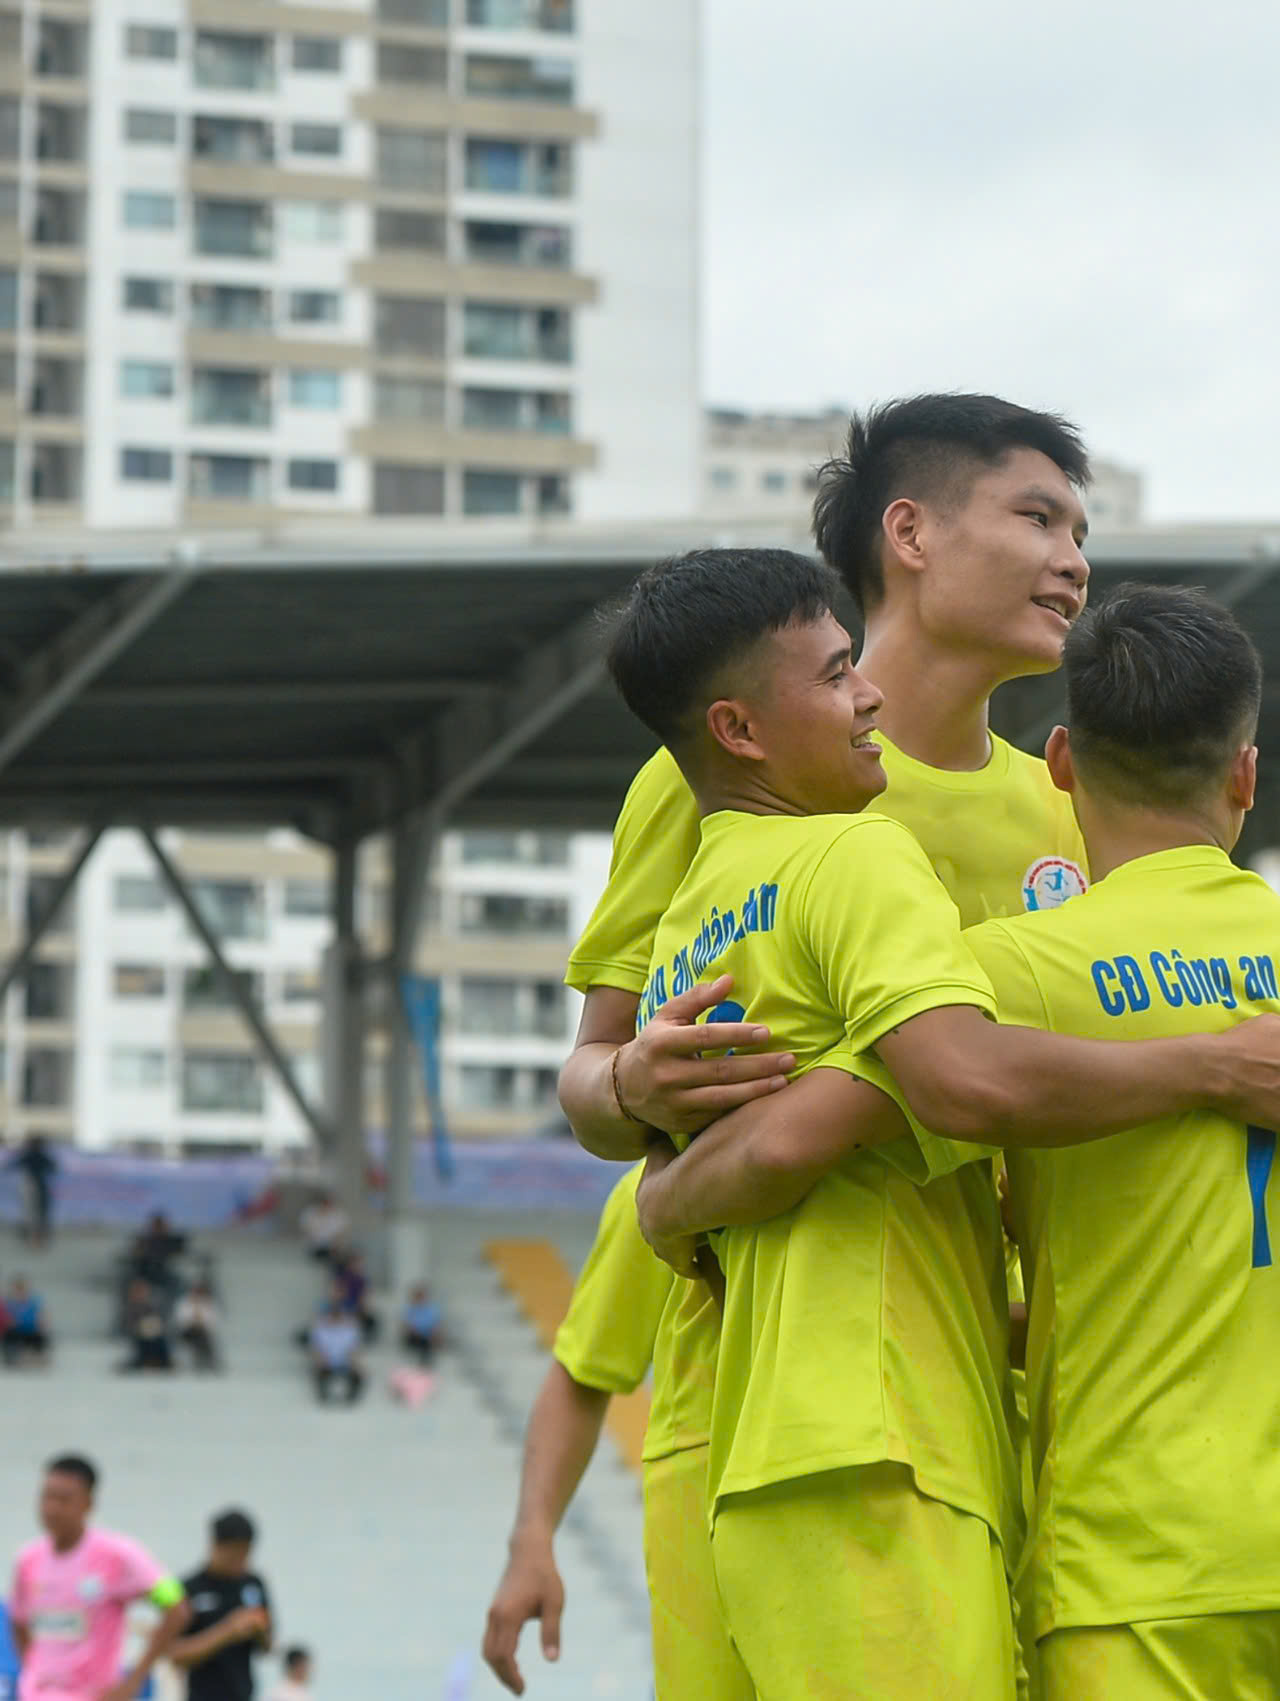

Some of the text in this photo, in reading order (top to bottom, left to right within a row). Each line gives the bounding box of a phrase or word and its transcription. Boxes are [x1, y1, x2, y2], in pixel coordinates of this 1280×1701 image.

[1091, 955, 1151, 1017] CĐ
[1149, 949, 1237, 1009] Công
[1239, 955, 1277, 1001] an
